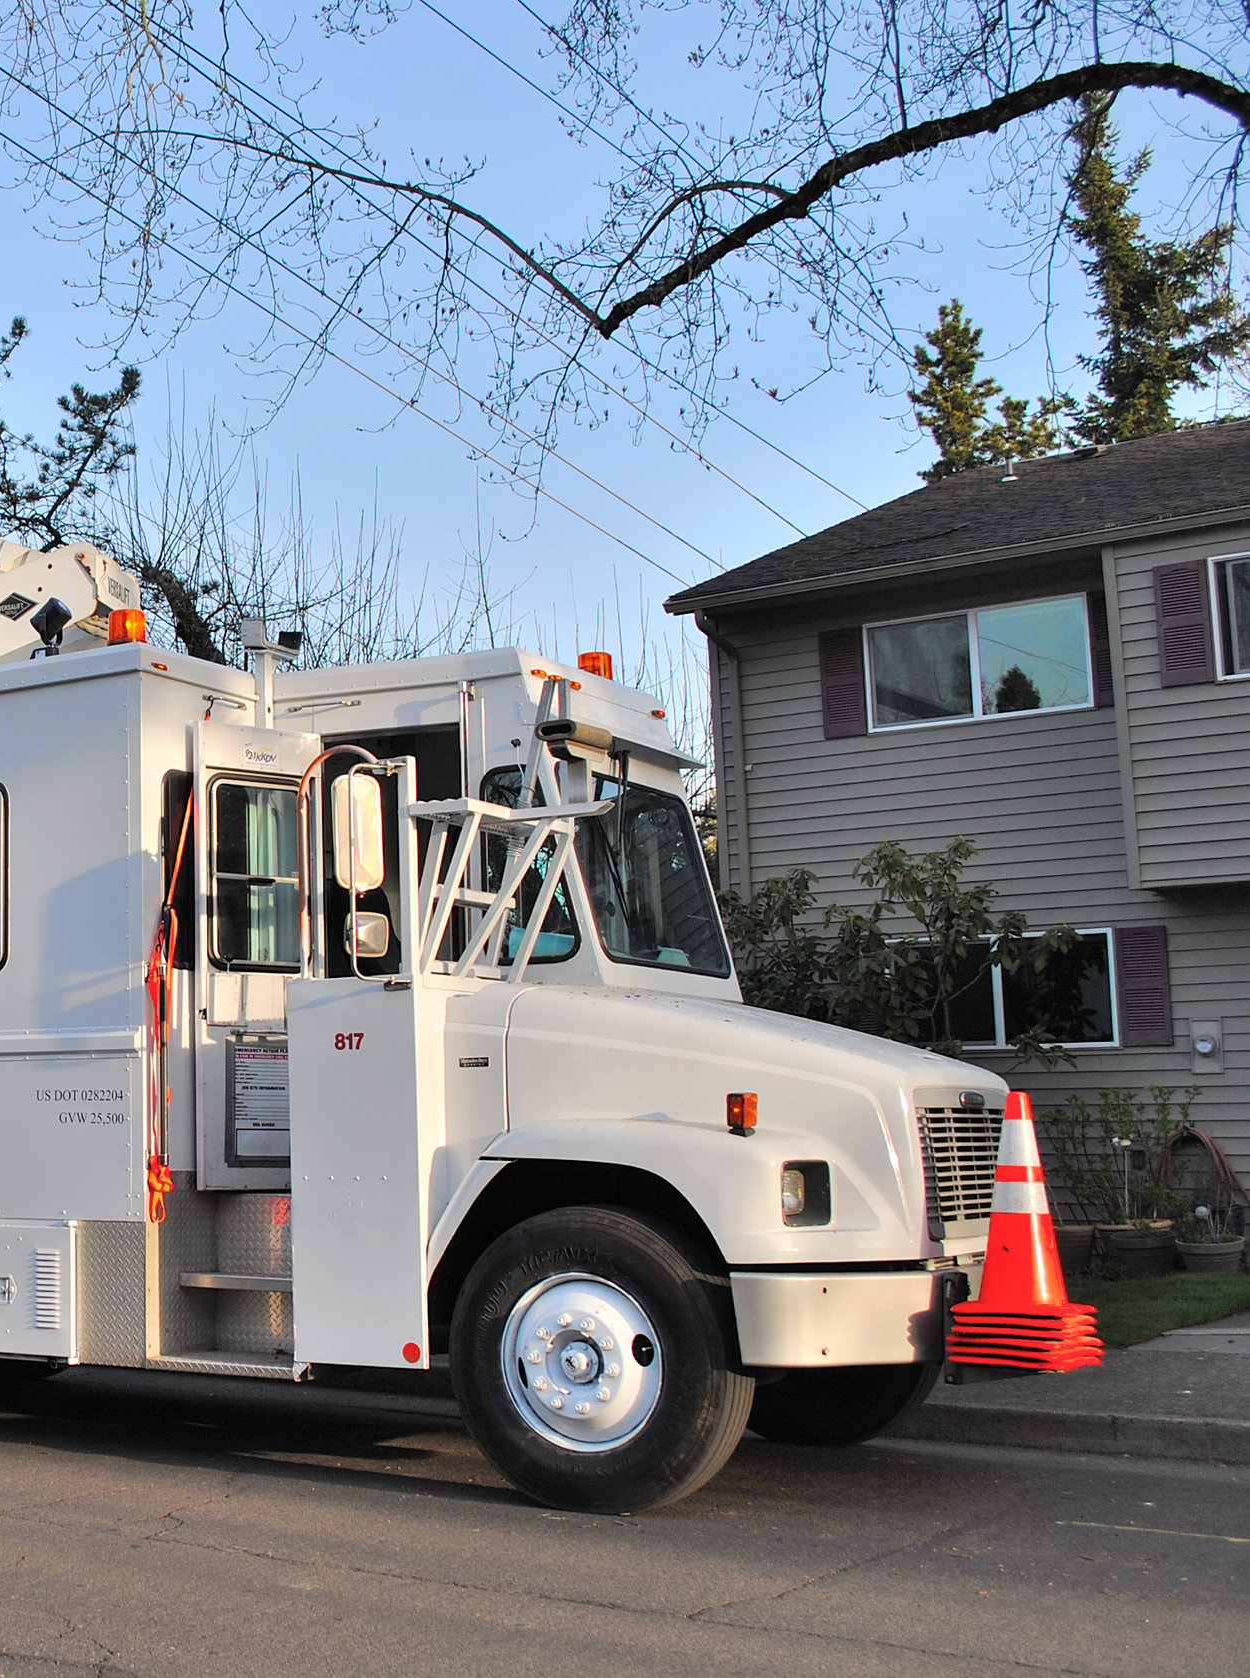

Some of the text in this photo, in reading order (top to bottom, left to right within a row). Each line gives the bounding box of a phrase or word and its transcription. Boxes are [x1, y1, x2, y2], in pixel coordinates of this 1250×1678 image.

[334, 1033, 364, 1050] 817
[36, 1090, 124, 1101] US DOT 0282204
[59, 1112, 124, 1125] GVW 25,500
